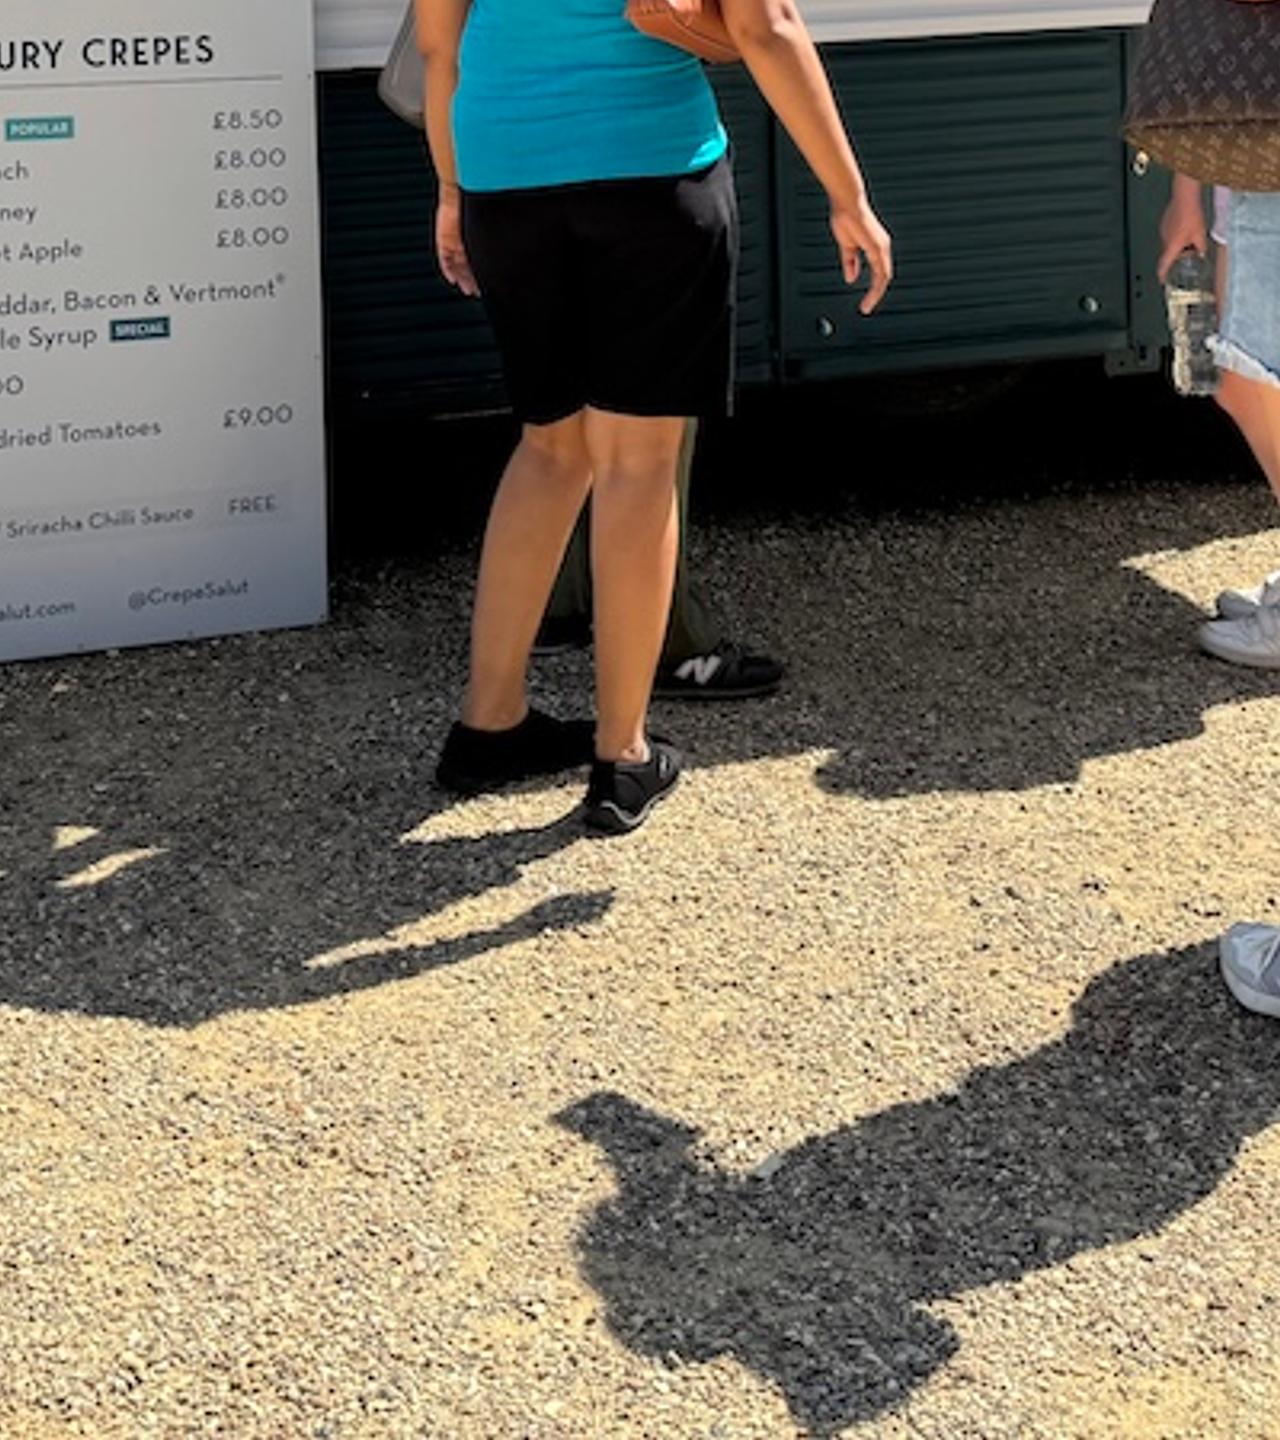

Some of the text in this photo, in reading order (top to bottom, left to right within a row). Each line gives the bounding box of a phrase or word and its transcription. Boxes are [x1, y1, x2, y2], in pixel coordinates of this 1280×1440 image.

[83, 35, 213, 67] CREPES
[9, 120, 69, 136] POPULAR
[213, 109, 283, 130] £8.50
[214, 147, 286, 170] £8.00
[215, 186, 288, 209] £8.00
[216, 226, 289, 248] £8.00
[19, 238, 82, 264] Apple
[64, 290, 136, 311] Bacon
[144, 285, 160, 305] &
[29, 326, 97, 352] Syrup
[224, 404, 293, 428] £9.00
[59, 422, 162, 443] Tomatoes
[229, 495, 277, 514] FREE
[7, 516, 83, 538] Sriracha
[88, 510, 135, 530] Chilli
[141, 507, 194, 525] Sauce
[127, 576, 249, 611] @CrepeSalut
